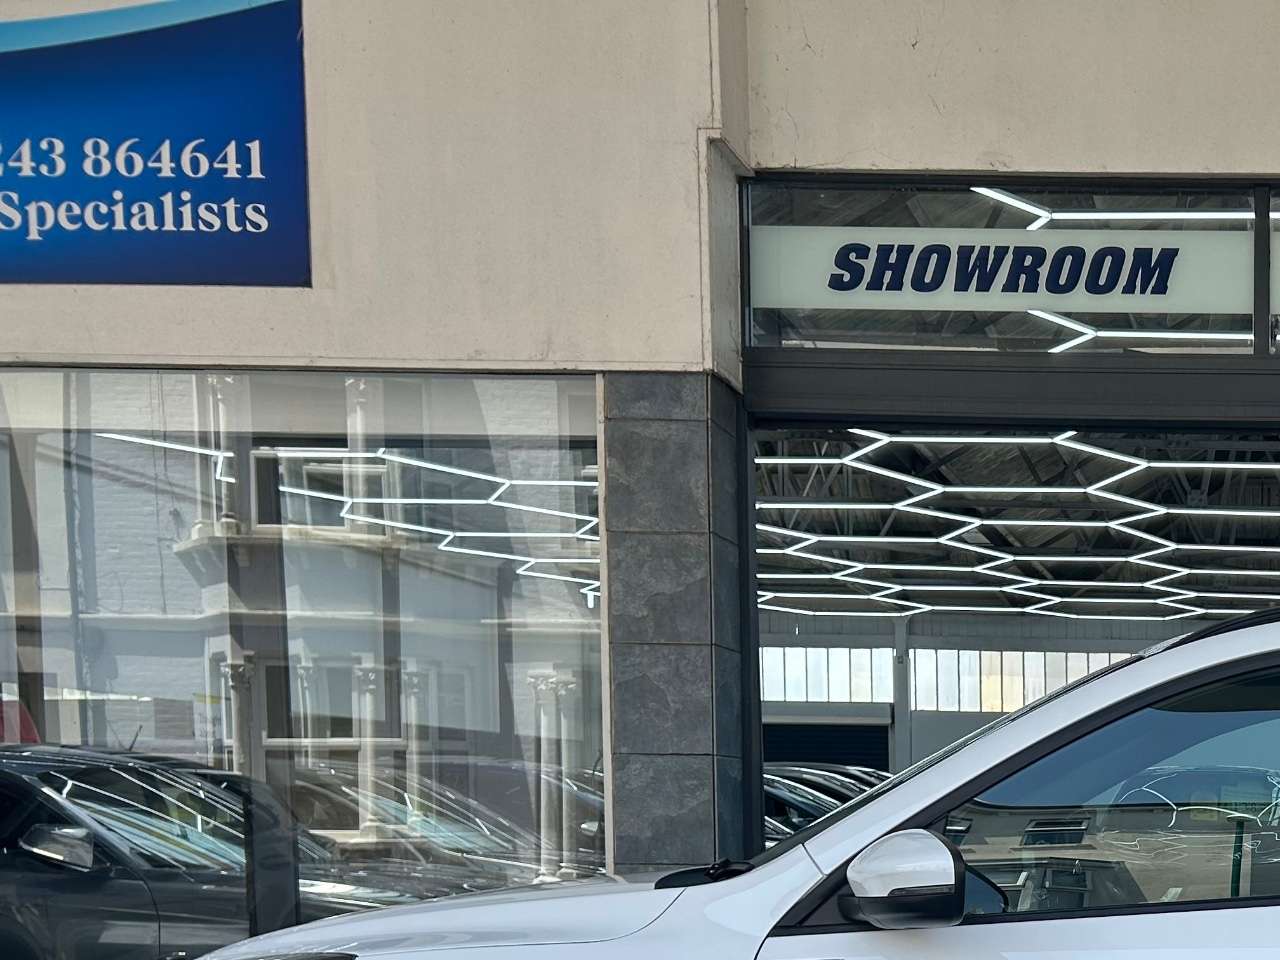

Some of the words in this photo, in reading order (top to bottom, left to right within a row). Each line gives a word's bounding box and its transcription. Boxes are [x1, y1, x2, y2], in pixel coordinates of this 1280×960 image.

[0, 138, 66, 176] 43
[83, 138, 265, 178] 864641
[0, 190, 269, 240] Specialists
[828, 242, 1180, 295] SHOWROOM
